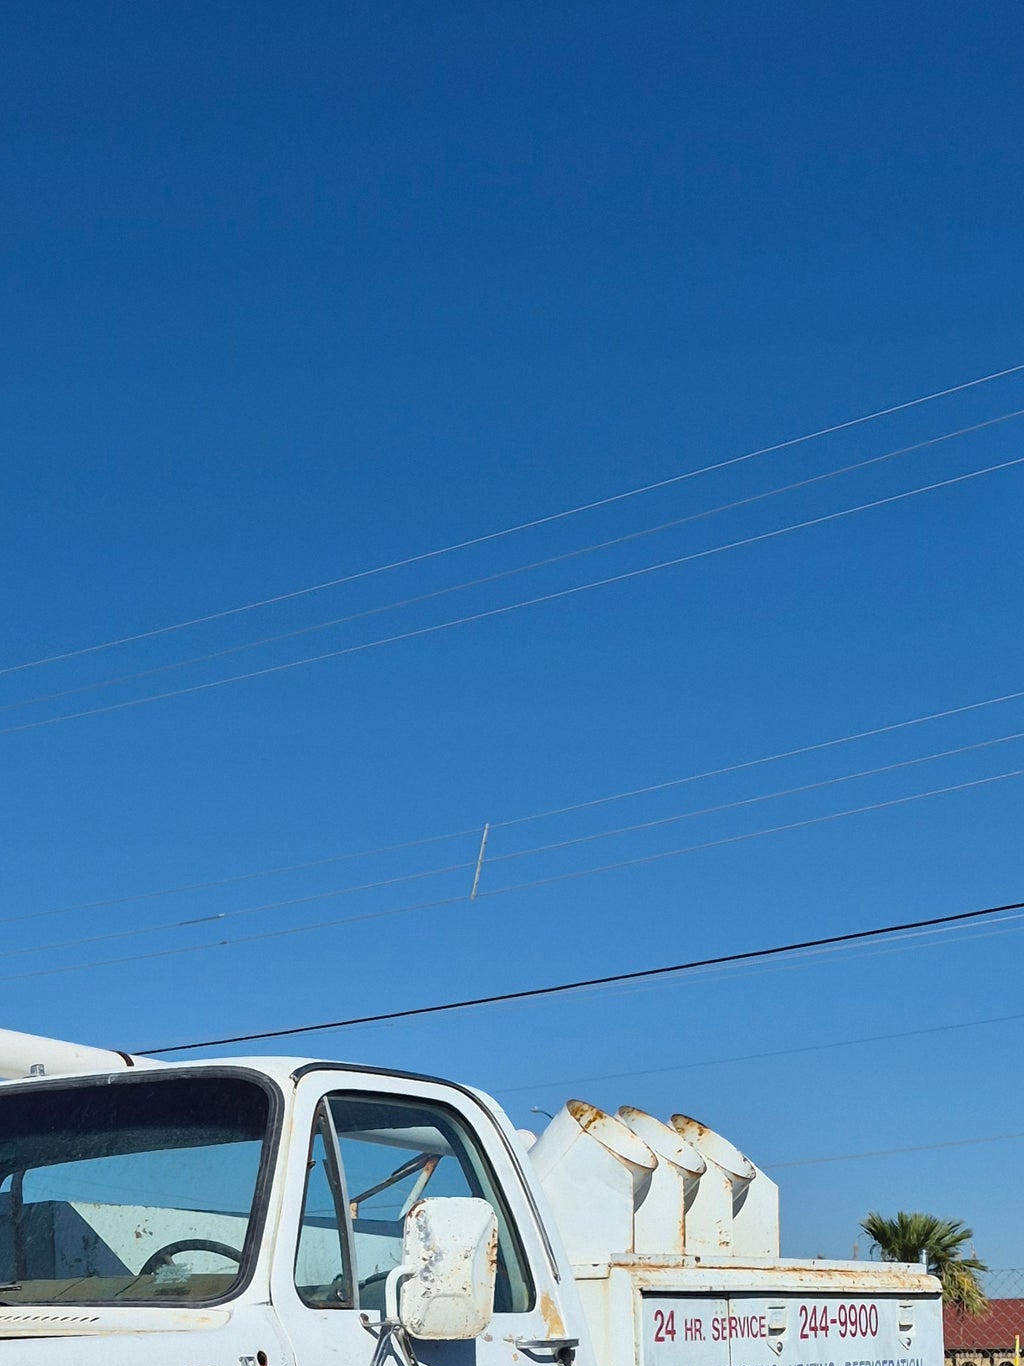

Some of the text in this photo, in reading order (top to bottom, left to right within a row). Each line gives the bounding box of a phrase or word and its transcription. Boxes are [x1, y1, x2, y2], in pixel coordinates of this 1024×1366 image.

[653, 1303, 879, 1343] 24 HR. SERVICE 244-9900
